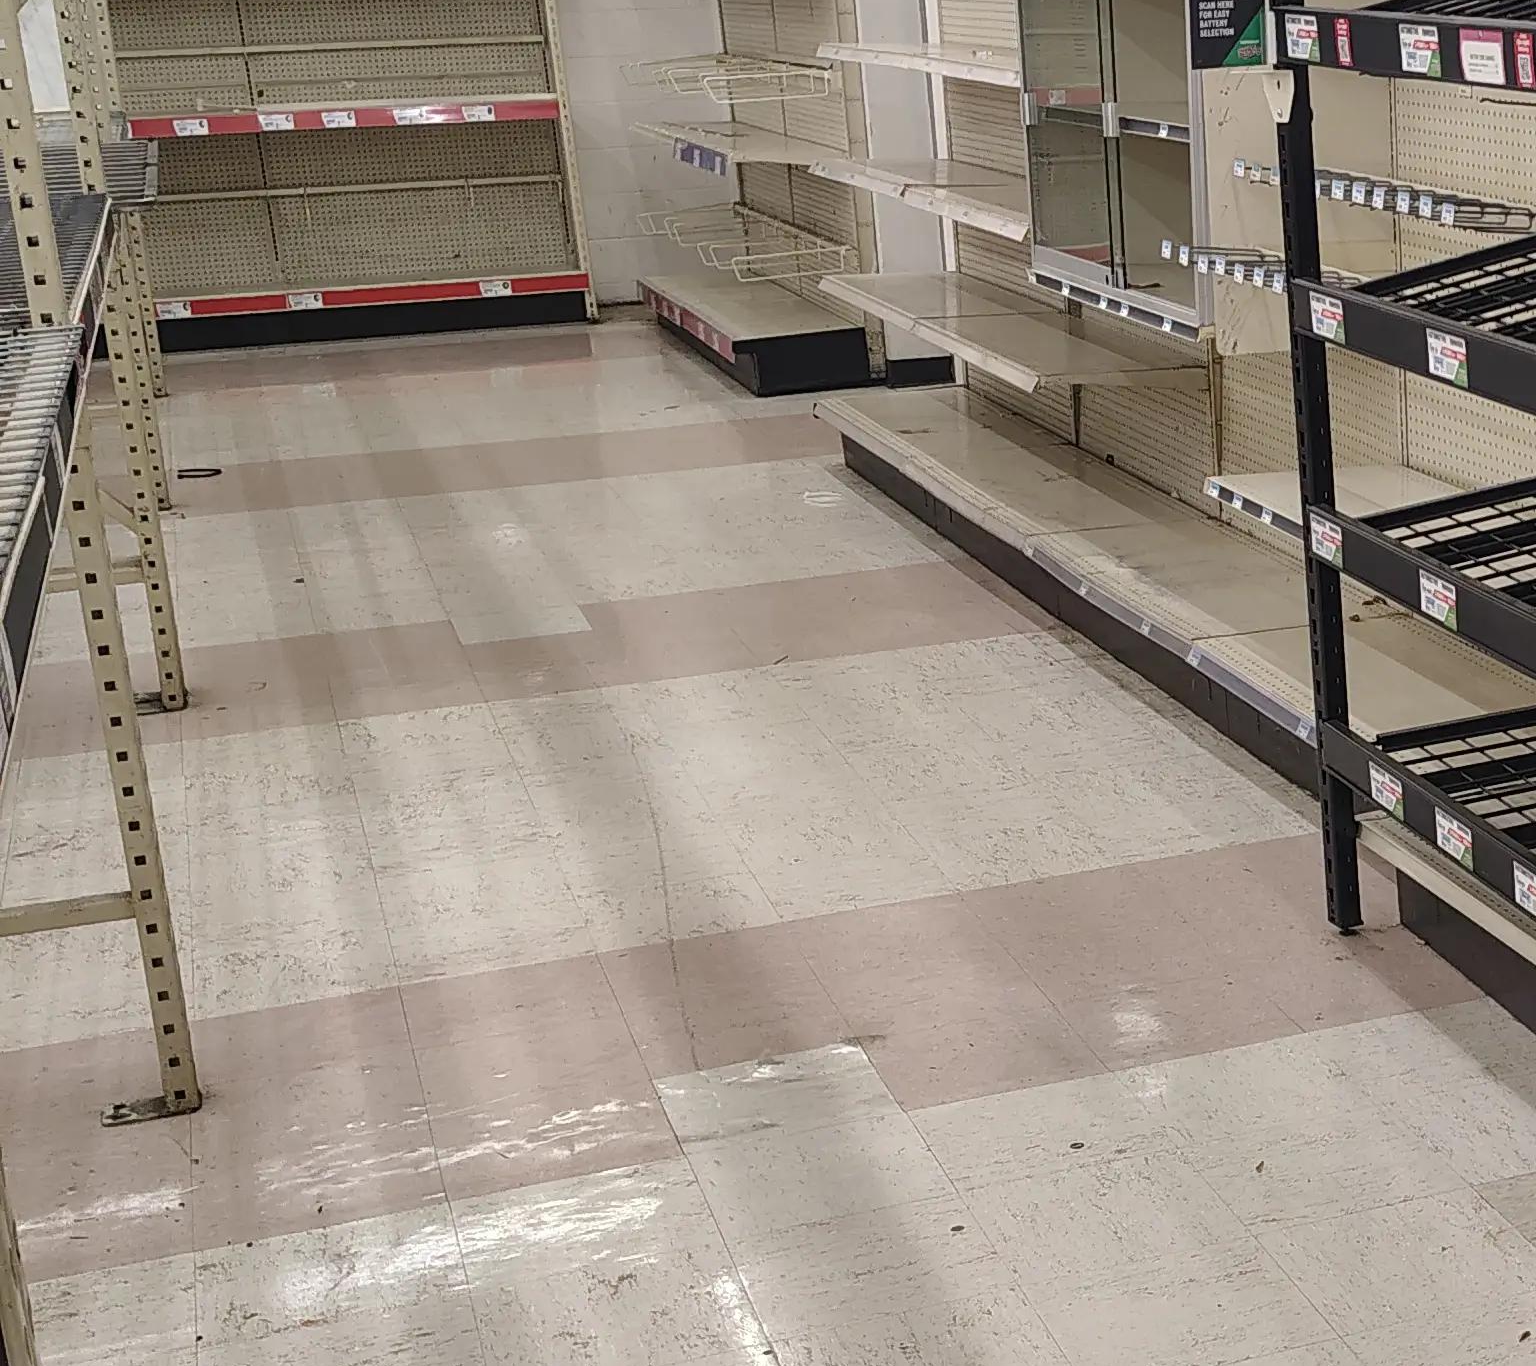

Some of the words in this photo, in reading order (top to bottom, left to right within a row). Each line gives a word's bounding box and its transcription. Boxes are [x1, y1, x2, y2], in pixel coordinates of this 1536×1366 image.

[1199, 10, 1213, 19] FOR
[1199, 19, 1229, 29] BATTERY
[1200, 27, 1235, 38] SELECTION
